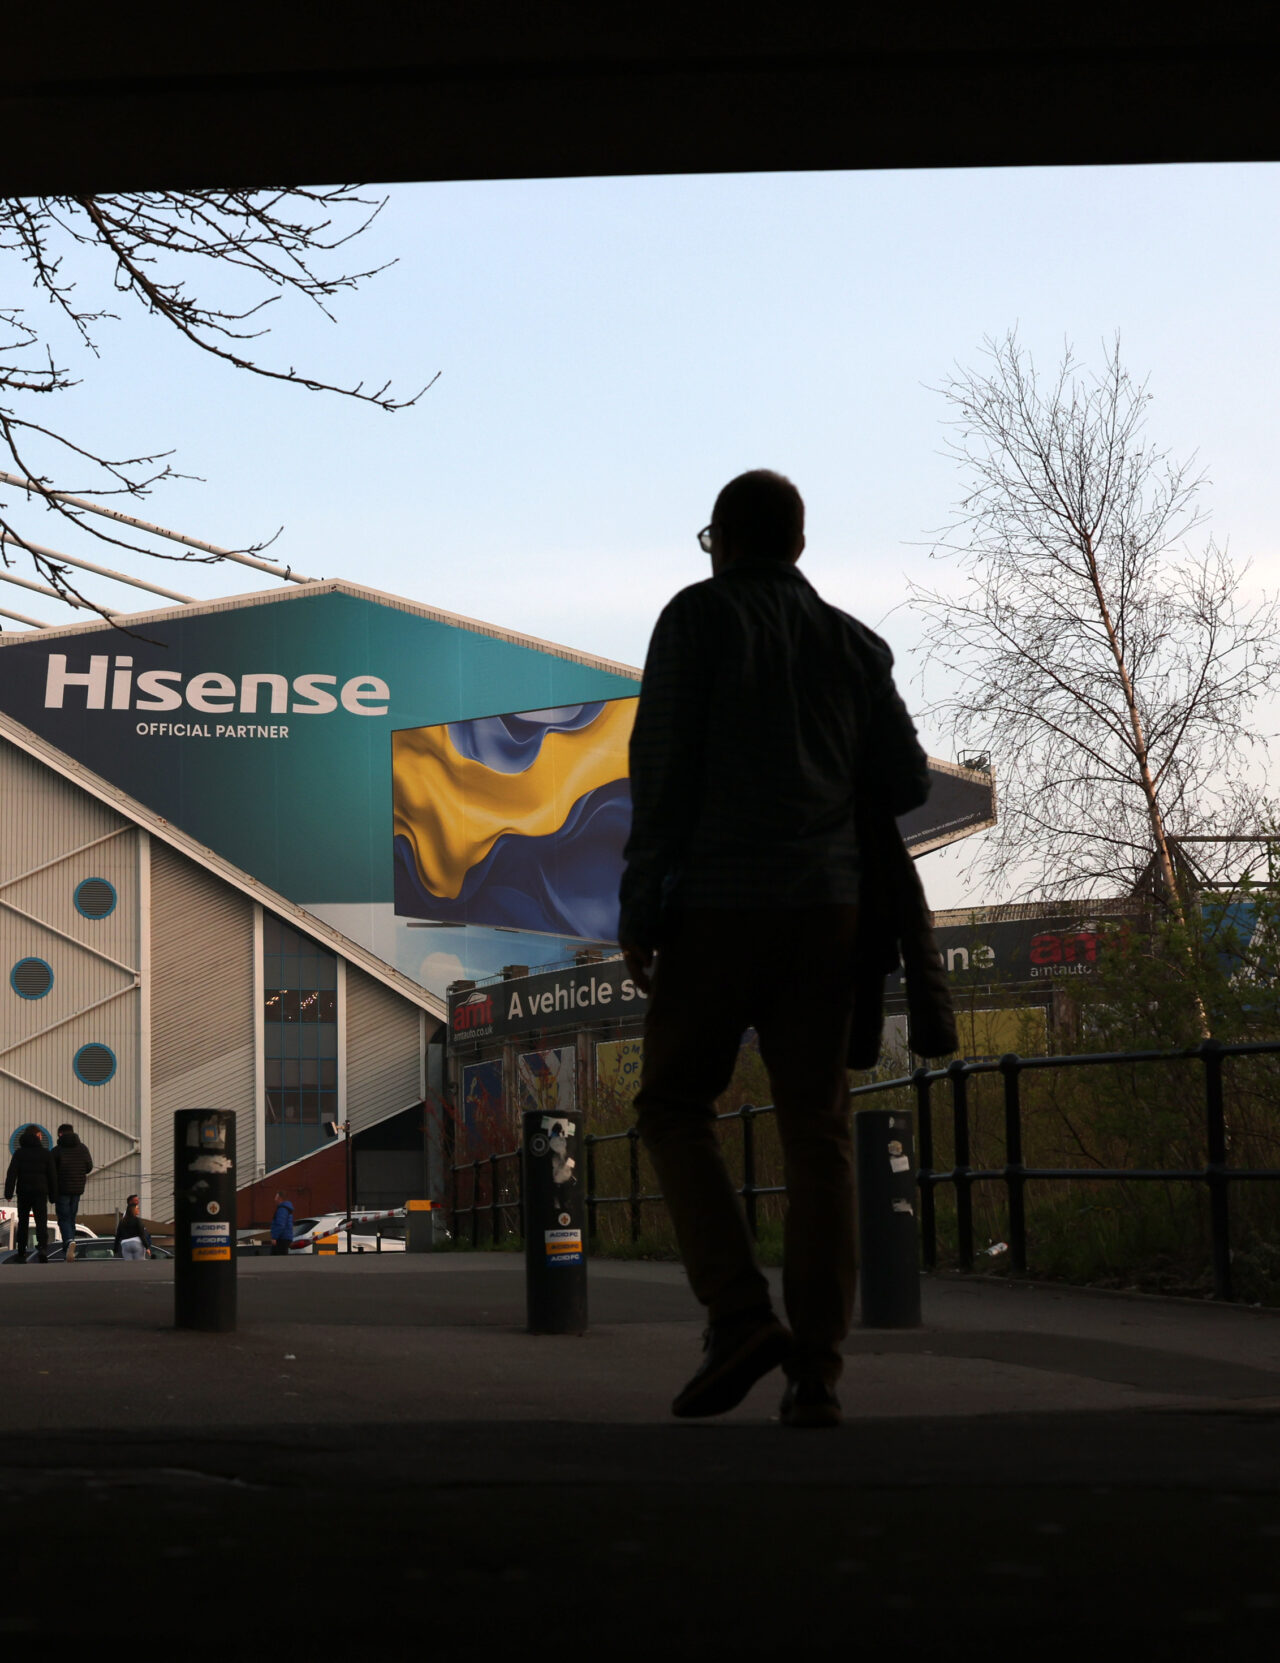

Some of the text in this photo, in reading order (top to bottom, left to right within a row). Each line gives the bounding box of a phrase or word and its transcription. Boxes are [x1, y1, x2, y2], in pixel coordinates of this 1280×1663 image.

[44, 653, 391, 716] Hisense
[136, 722, 290, 739] OFFICIAL PARTNER
[453, 994, 495, 1031] amt
[507, 991, 524, 1020] A
[528, 977, 613, 1016] vehicle
